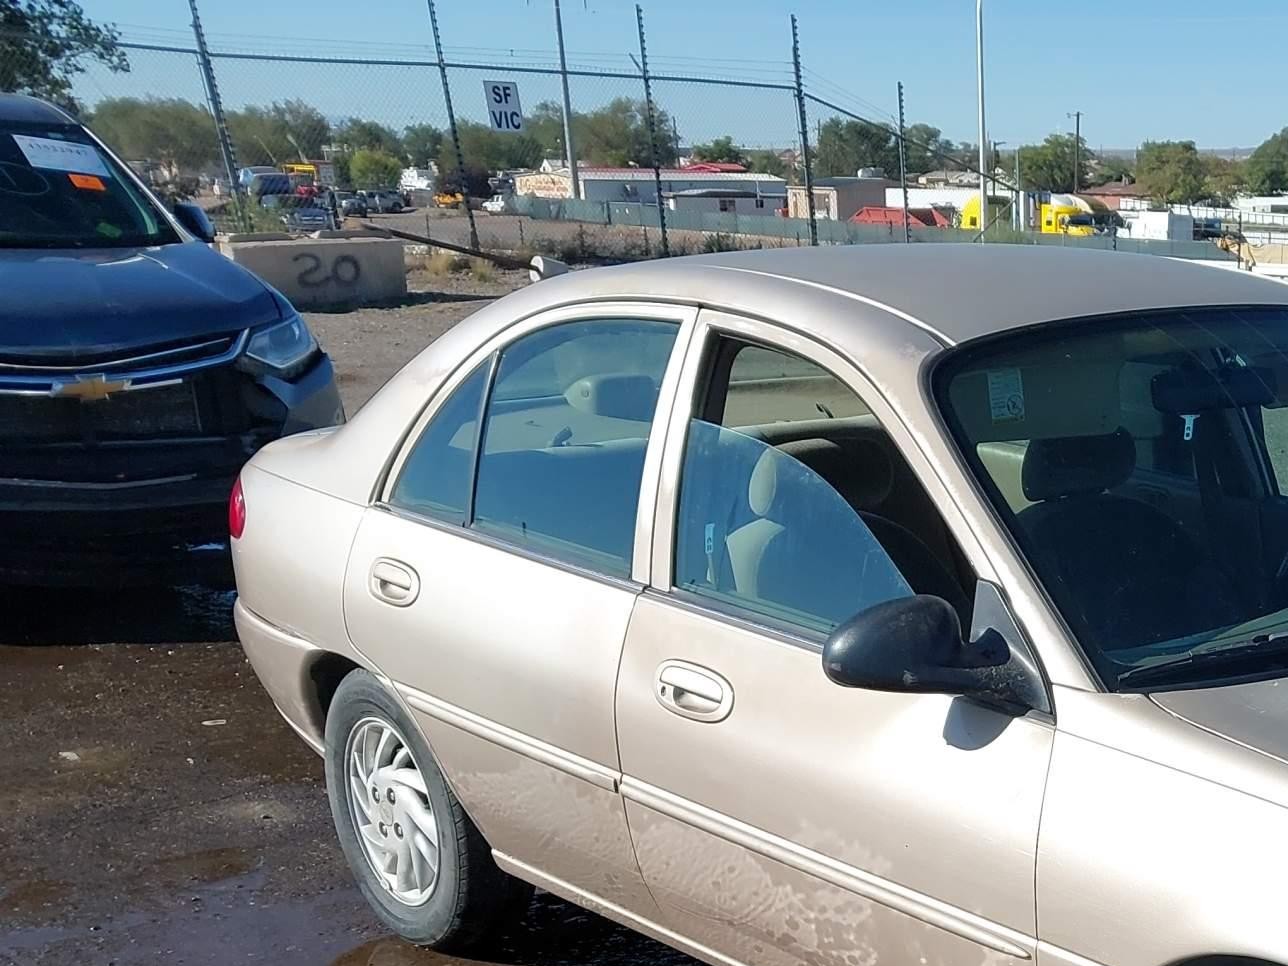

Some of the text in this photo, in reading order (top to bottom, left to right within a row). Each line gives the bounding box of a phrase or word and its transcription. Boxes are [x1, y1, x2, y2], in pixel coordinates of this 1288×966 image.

[492, 85, 511, 104] SF
[489, 110, 521, 130] VIC
[292, 252, 361, 289] 20
